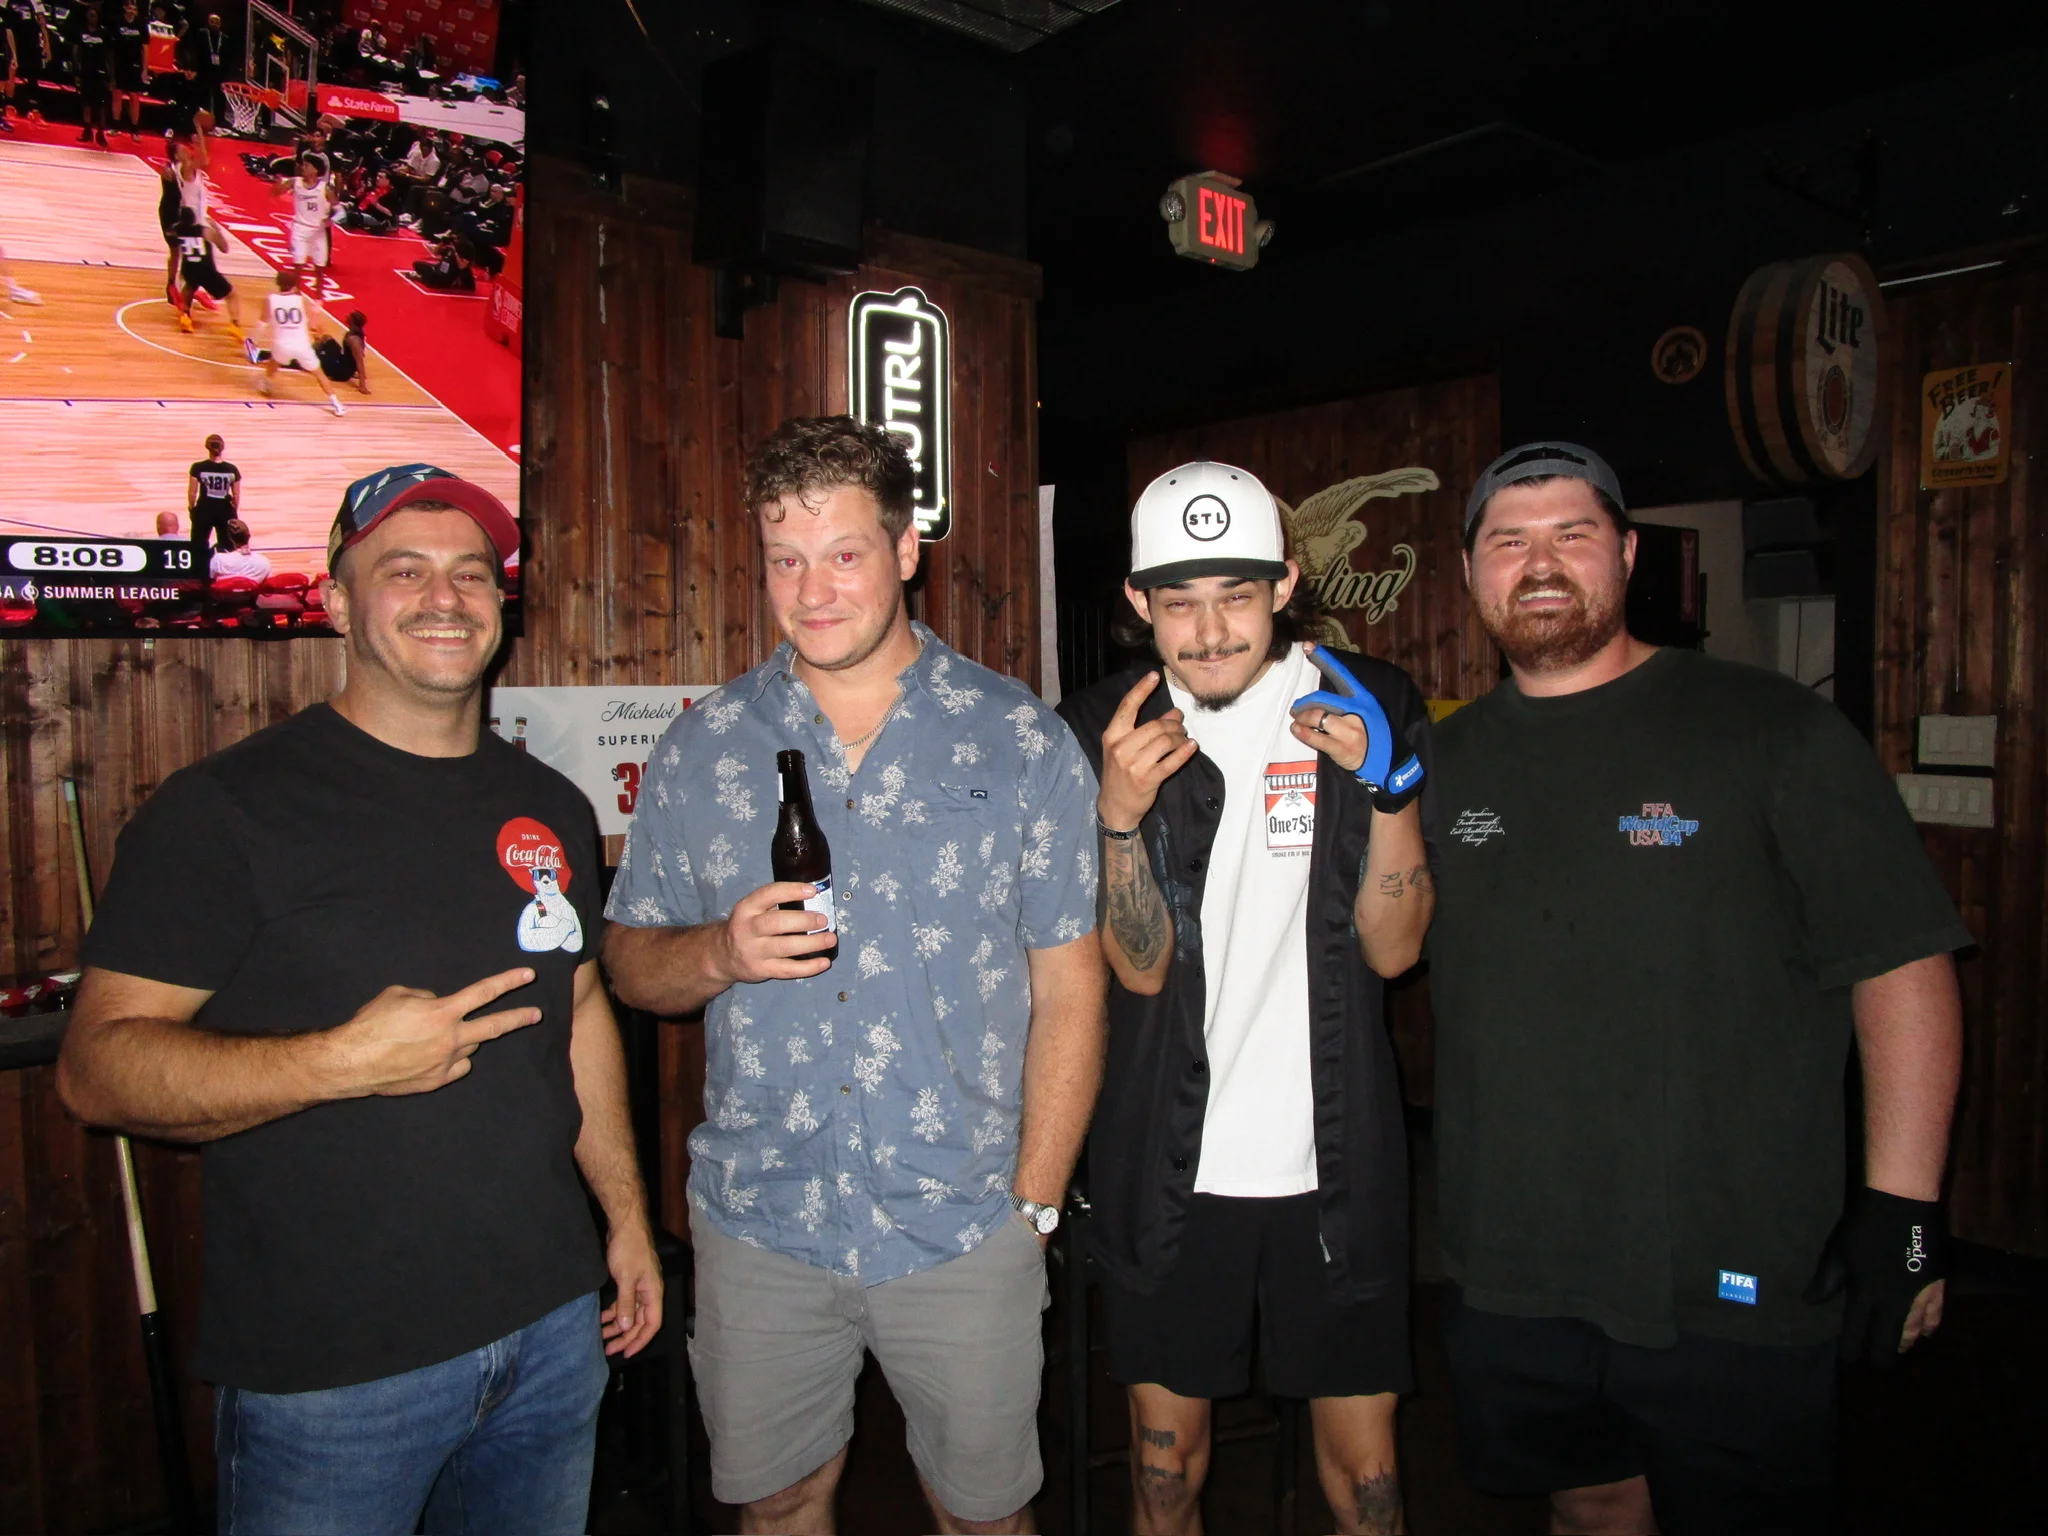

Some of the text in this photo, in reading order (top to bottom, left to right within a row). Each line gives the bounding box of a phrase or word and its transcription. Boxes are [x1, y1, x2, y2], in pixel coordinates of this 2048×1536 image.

[1199, 187, 1247, 255] EXIT
[275, 307, 302, 325] 00
[1817, 280, 1864, 356] Lite
[1926, 368, 1979, 410] FREE
[1940, 370, 2004, 421] BEER!
[1189, 512, 1225, 526] STL
[33, 546, 192, 569] 8:08 19
[44, 585, 115, 600] SUMMER
[120, 586, 180, 601] LEAGUE
[600, 700, 676, 722] Michelob
[611, 761, 649, 815] $3
[1642, 803, 1674, 817] FIFA
[521, 833, 541, 841] DRINK
[1906, 1225, 1927, 1273] Opera
[1722, 1272, 1754, 1289] FIFA
[1721, 1291, 1754, 1302] CLASSICS
